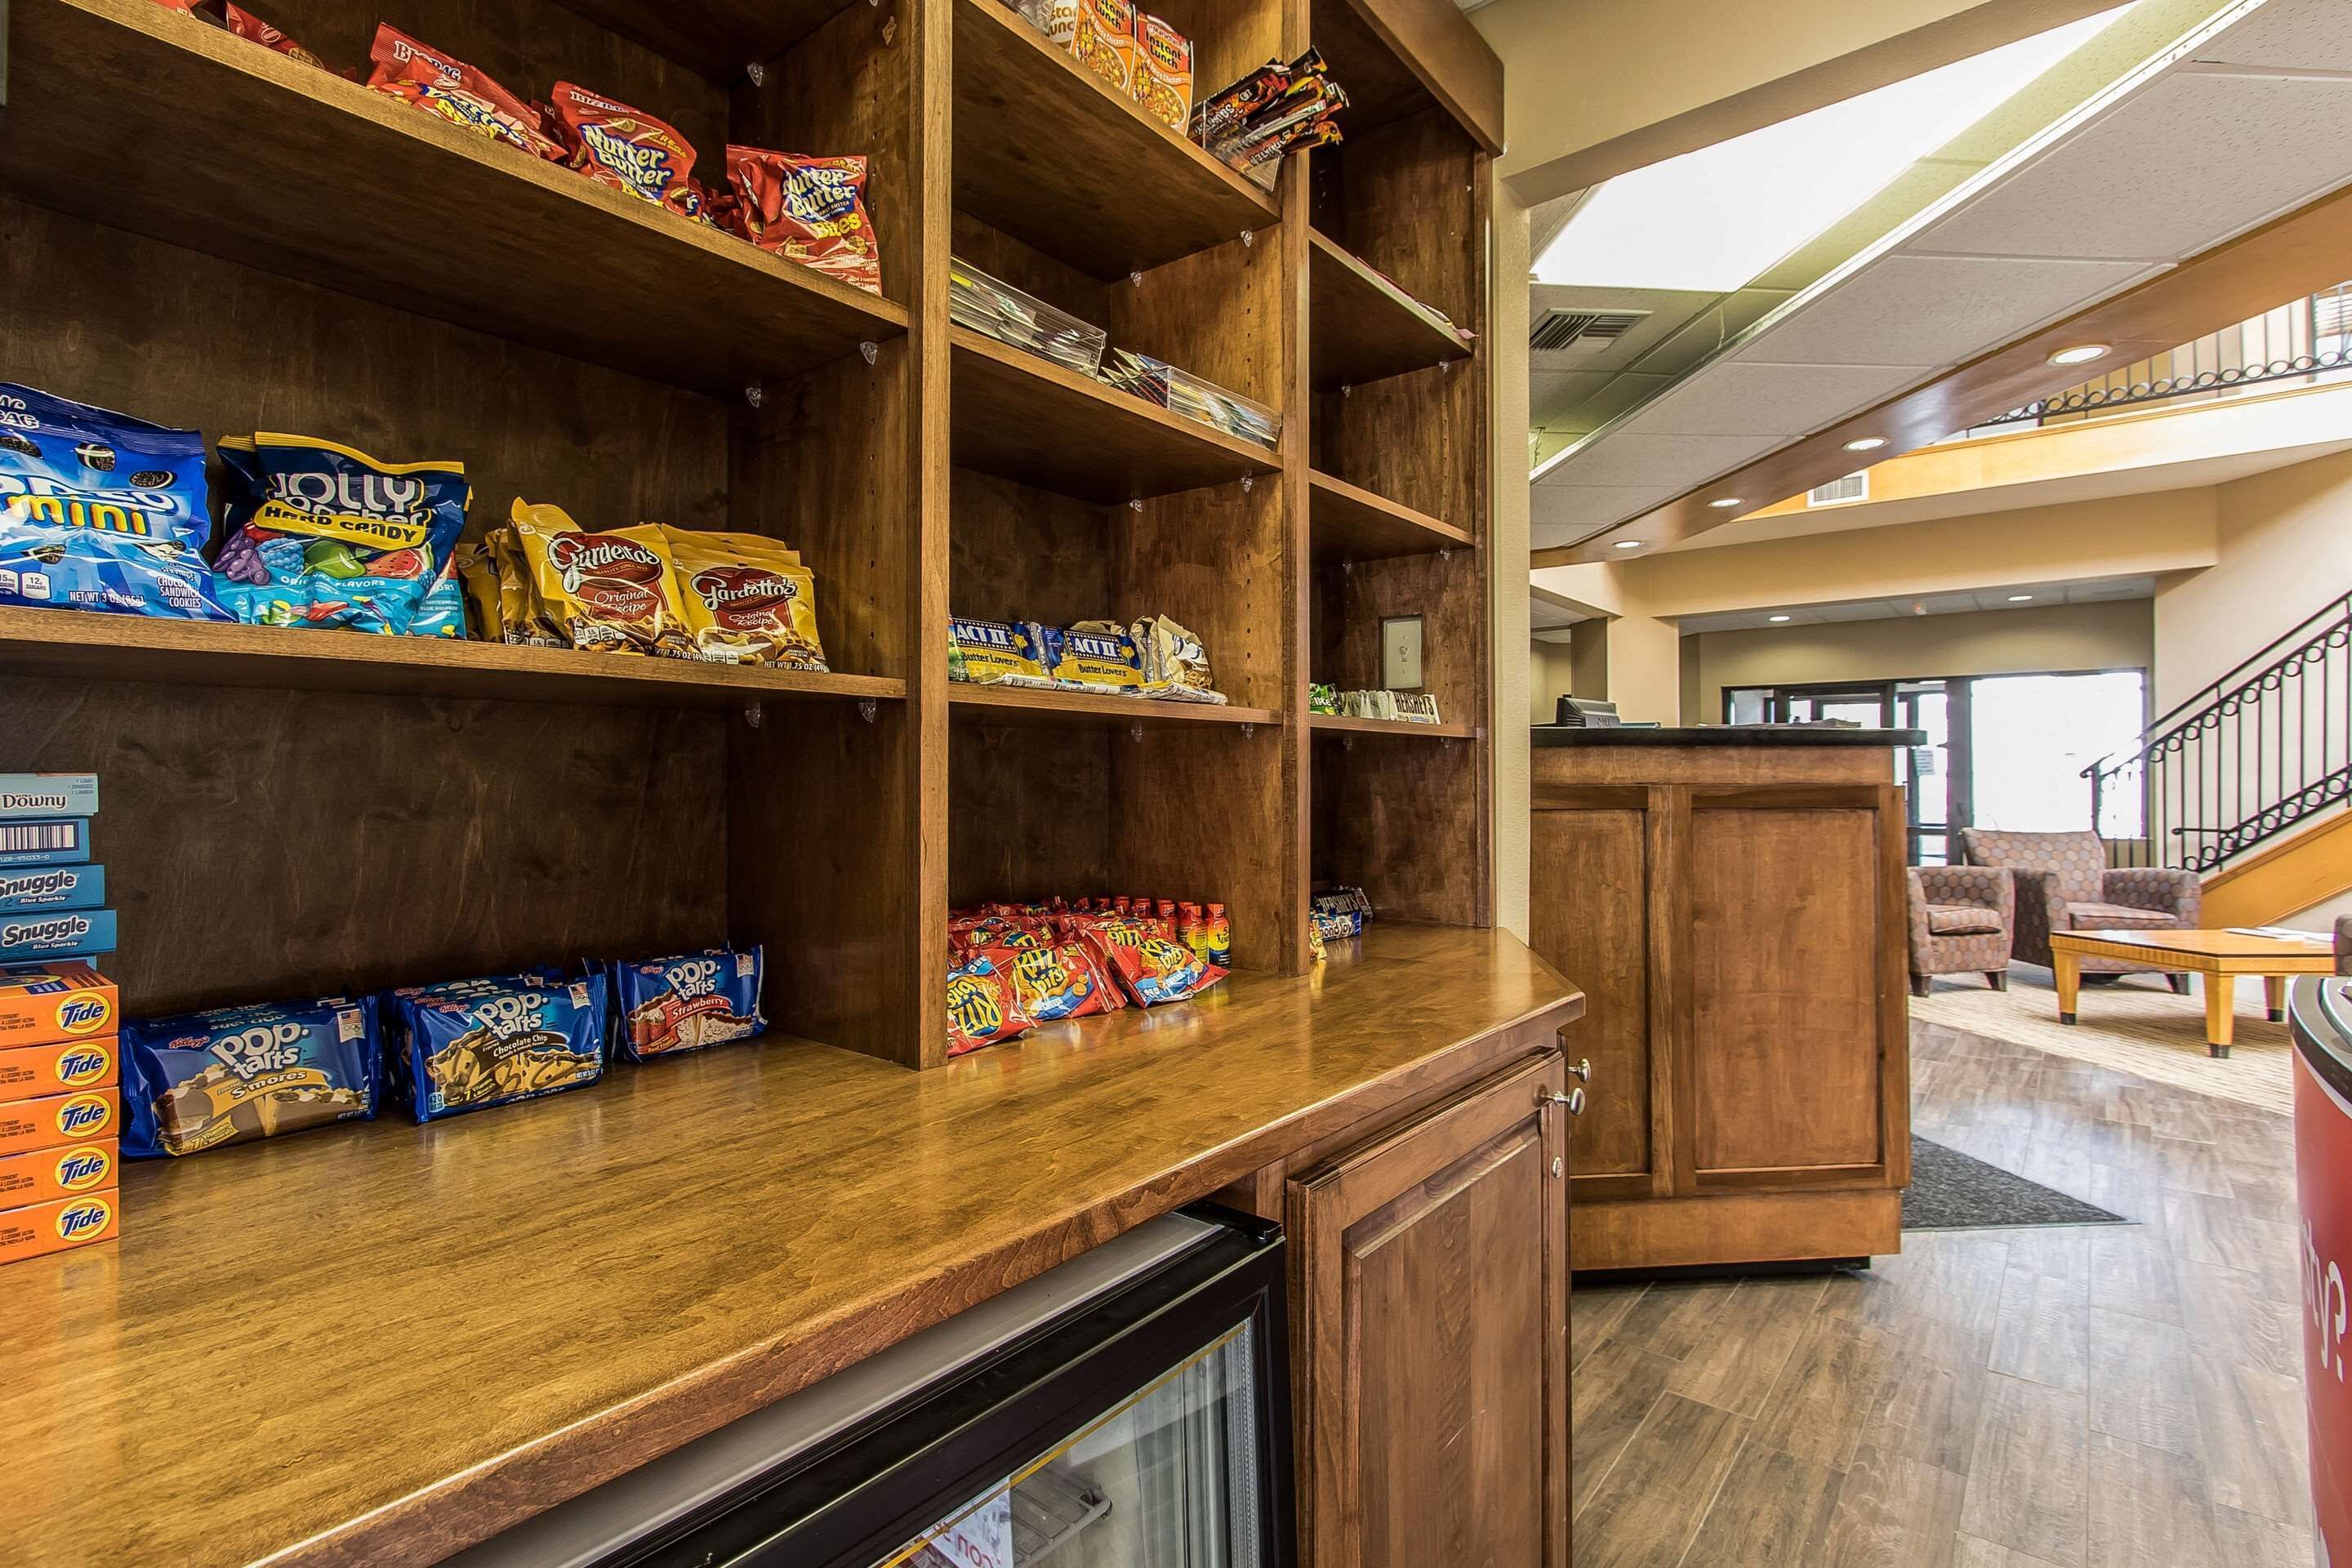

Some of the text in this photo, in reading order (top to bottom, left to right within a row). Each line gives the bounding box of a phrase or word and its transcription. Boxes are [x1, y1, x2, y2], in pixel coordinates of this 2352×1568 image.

[1145, 30, 1182, 61] Instant
[1150, 44, 1178, 70] Lunch
[581, 124, 666, 168] Nutter
[594, 147, 671, 186] Butter
[790, 184, 856, 217] Butter
[813, 212, 862, 240] Bites
[273, 473, 415, 512] JOLLY
[7, 493, 147, 536] mini
[265, 506, 332, 525] HARD
[340, 521, 418, 542] CANDY
[547, 536, 661, 594] Gardetto's
[70, 591, 85, 603] NET
[86, 592, 99, 603] WT
[101, 592, 108, 602] 3
[169, 597, 202, 608] COOKIES
[595, 587, 649, 605] Original
[728, 608, 776, 621] Original
[956, 624, 1009, 645] ACT II
[682, 649, 693, 660] OZ
[991, 654, 1020, 667] Lovers
[1075, 639, 1118, 657] ACT II
[804, 663, 813, 671] OZ
[1077, 663, 1128, 677] Butter Lovers
[1394, 693, 1435, 715] HERSHEY'S
[2, 794, 66, 809] Downy
[1319, 894, 1359, 914] HERSHEY'S
[3, 915, 87, 946] Snuggle
[50, 940, 78, 948] Sparkle
[1013, 949, 1058, 981] RITZ
[678, 978, 716, 1001] tarts
[1031, 967, 1064, 992] bits
[61, 1001, 106, 1028] Tide
[439, 1003, 470, 1013] Kellogg's
[672, 998, 724, 1020] Strawberry
[952, 993, 1003, 1034] RITZ
[492, 1012, 543, 1041] tarts
[169, 1036, 210, 1049] Kellogg's
[492, 1033, 549, 1059] Chocolate Chip
[61, 1054, 105, 1080] Tide
[234, 1045, 300, 1080] tarts
[232, 1070, 308, 1099] S'mores
[61, 1104, 106, 1132] Tide
[60, 1156, 105, 1185] Tide
[62, 1208, 106, 1236] Tide
